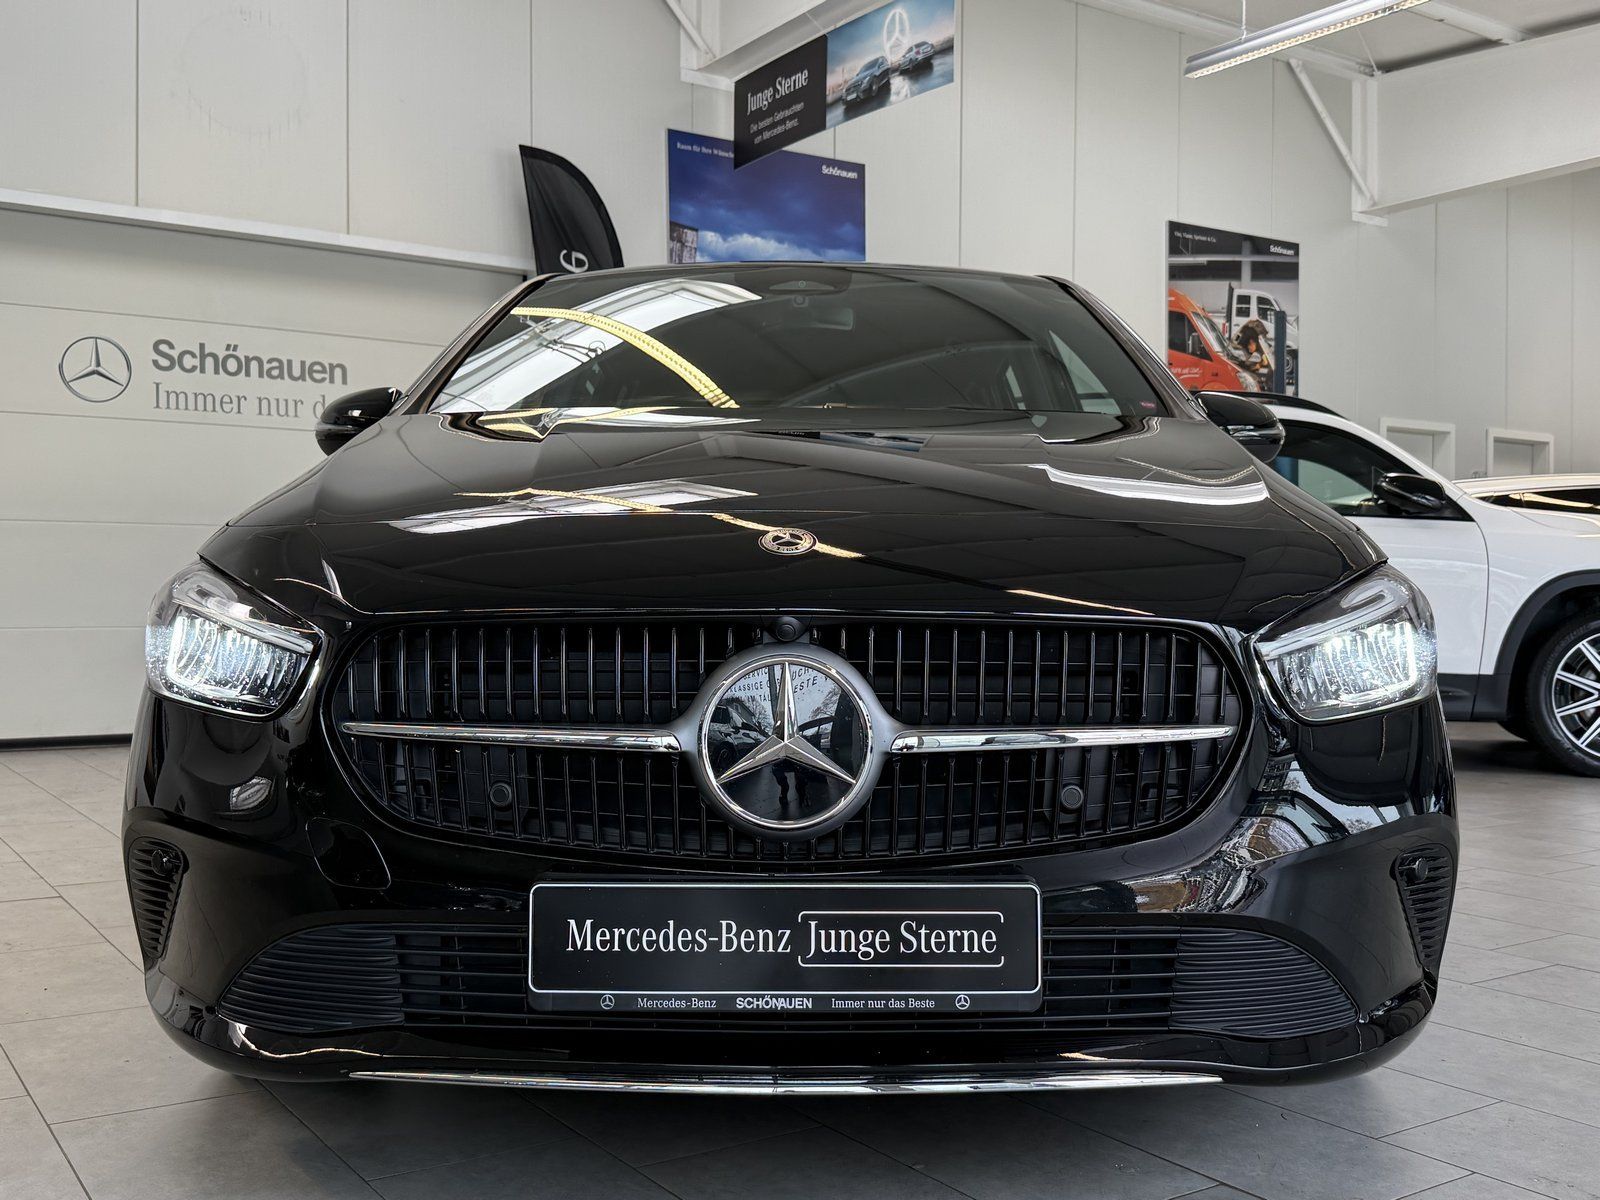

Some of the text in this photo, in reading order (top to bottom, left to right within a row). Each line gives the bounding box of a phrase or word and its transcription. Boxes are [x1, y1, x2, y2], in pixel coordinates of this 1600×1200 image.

[747, 68, 809, 116] Junge Sterne
[821, 164, 858, 180] Schönauen
[151, 338, 348, 386] Schönauen
[152, 382, 247, 414] Immer
[256, 394, 304, 418] nur
[566, 919, 997, 961] Mercedes-Benz Junge Sterne
[637, 995, 936, 1010] Mercedes-Benz SCHÖNAUEN Immer nur das Beste
